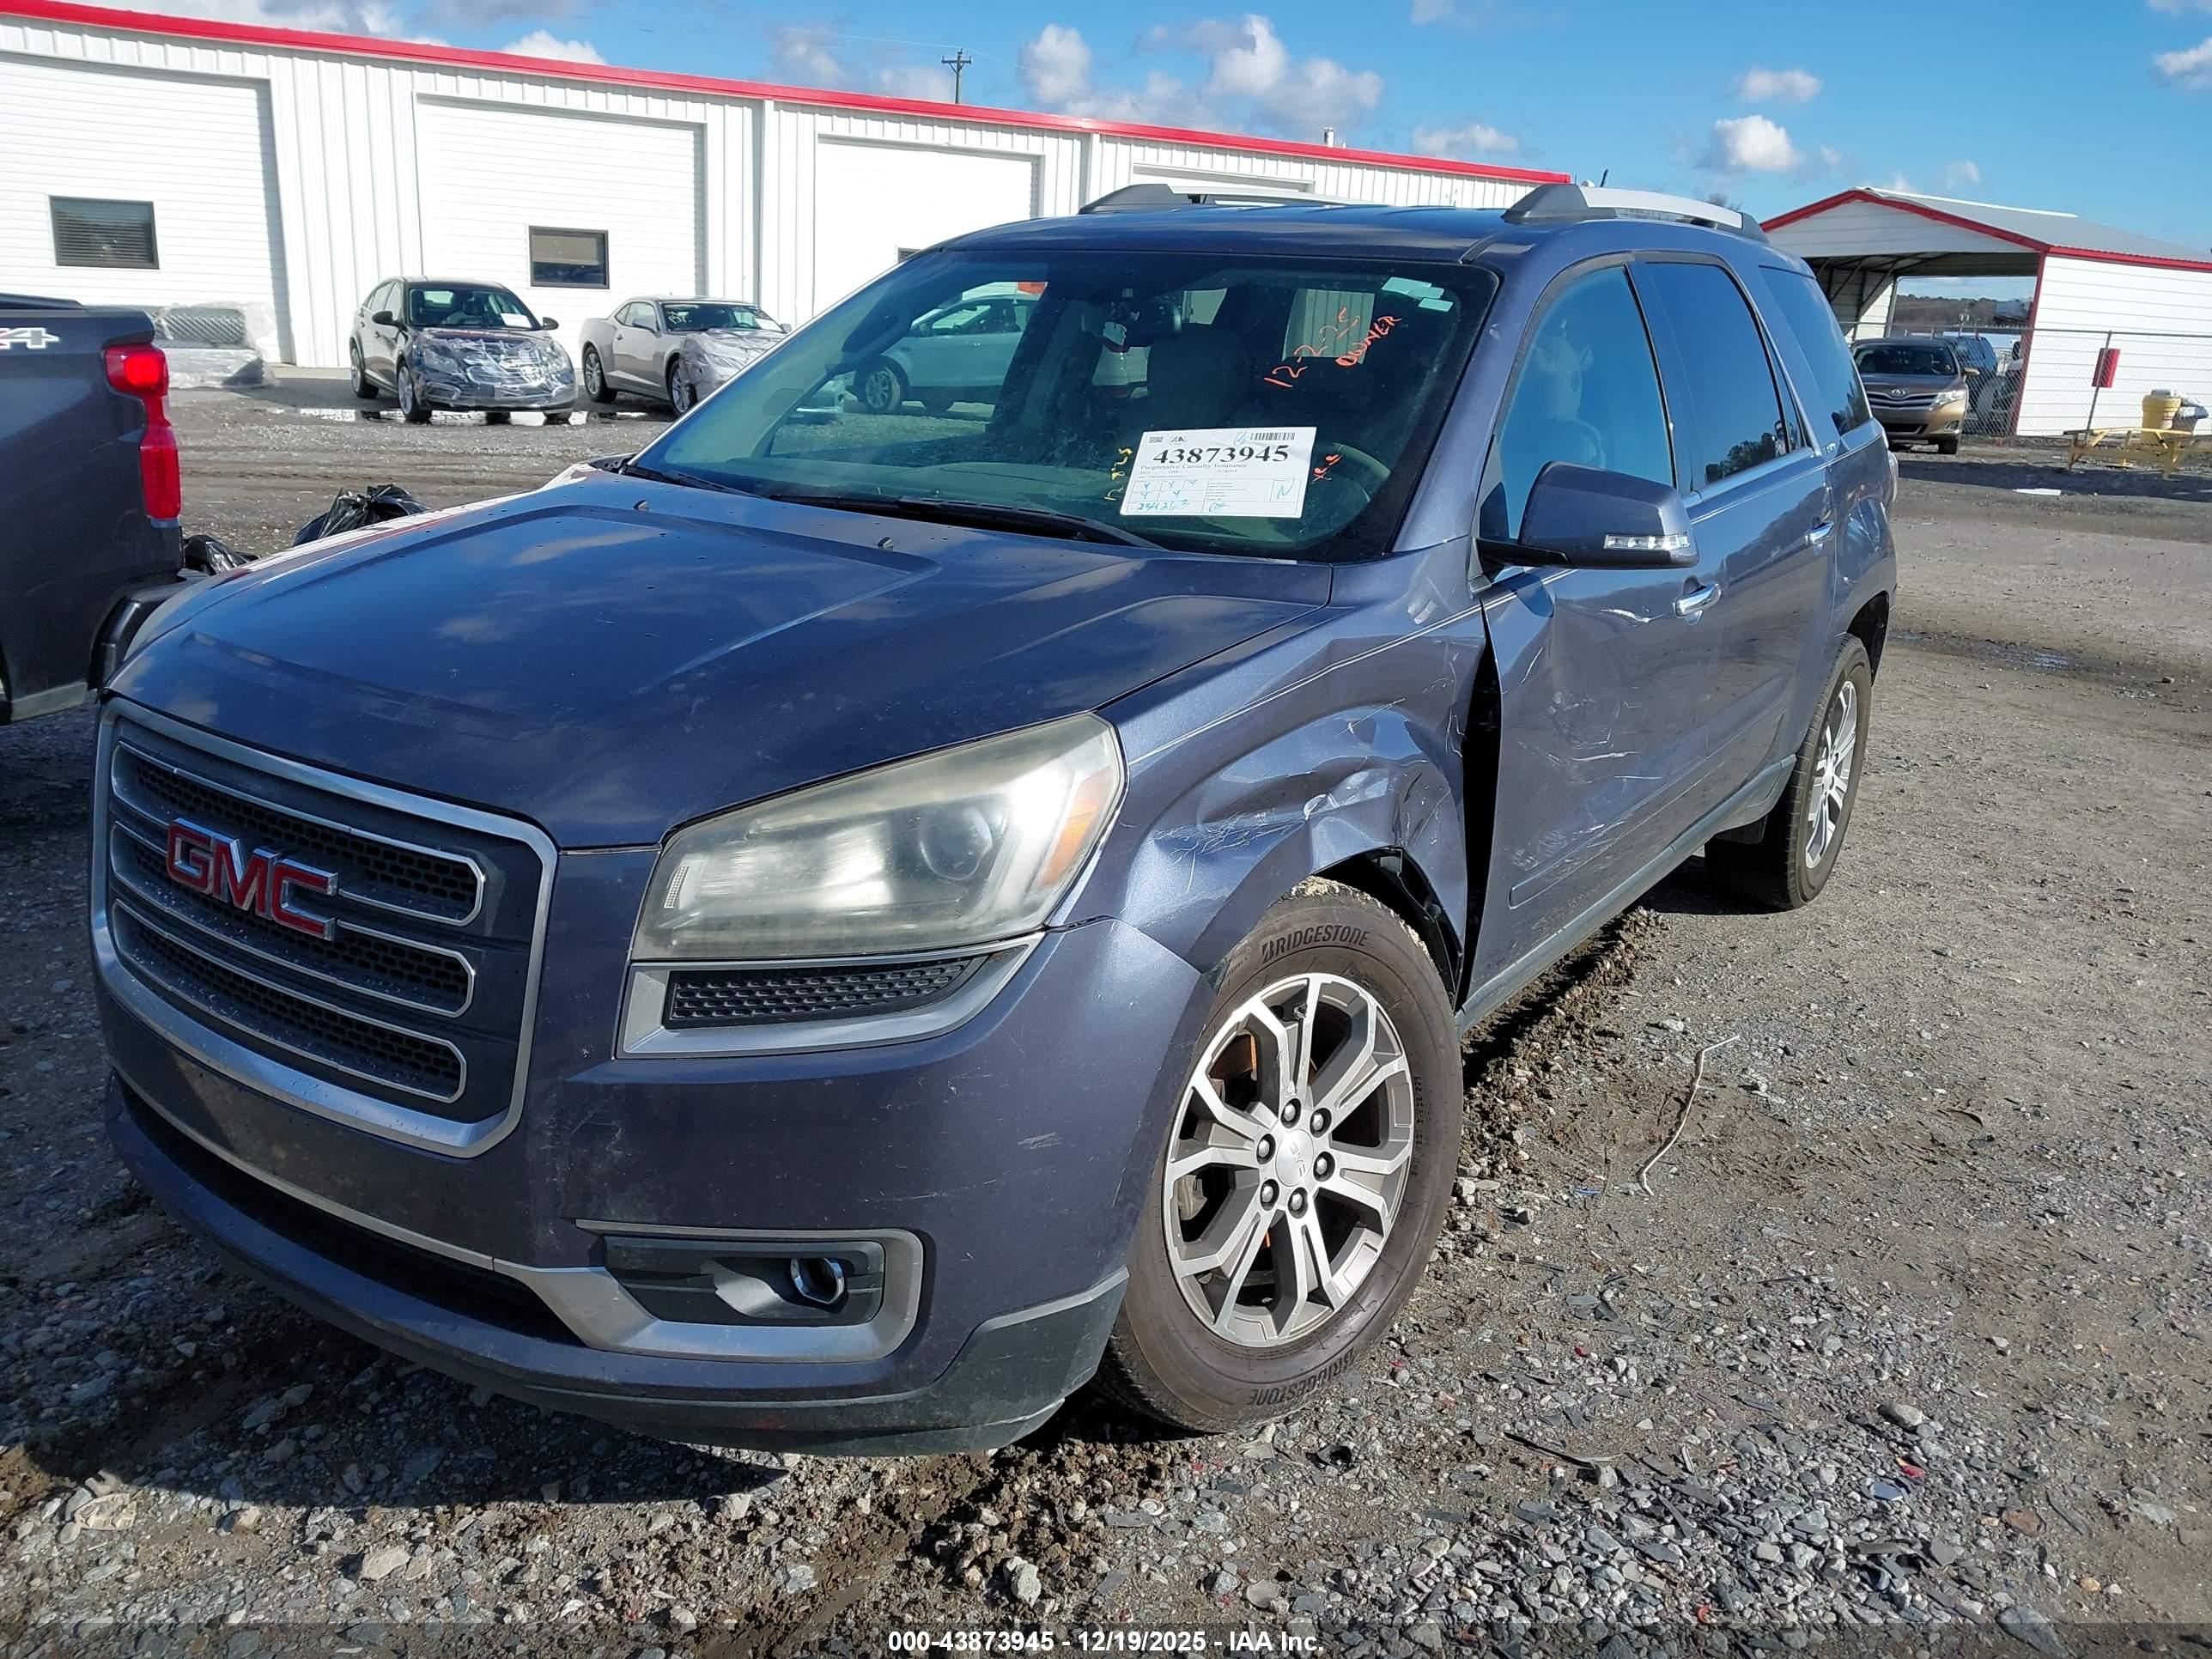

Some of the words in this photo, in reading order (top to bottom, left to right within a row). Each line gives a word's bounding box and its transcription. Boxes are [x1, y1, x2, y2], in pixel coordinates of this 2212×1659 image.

[1152, 445, 1290, 464] 43873945
[167, 817, 338, 941] GMC
[1261, 925, 1370, 963] BRIDGESTONE
